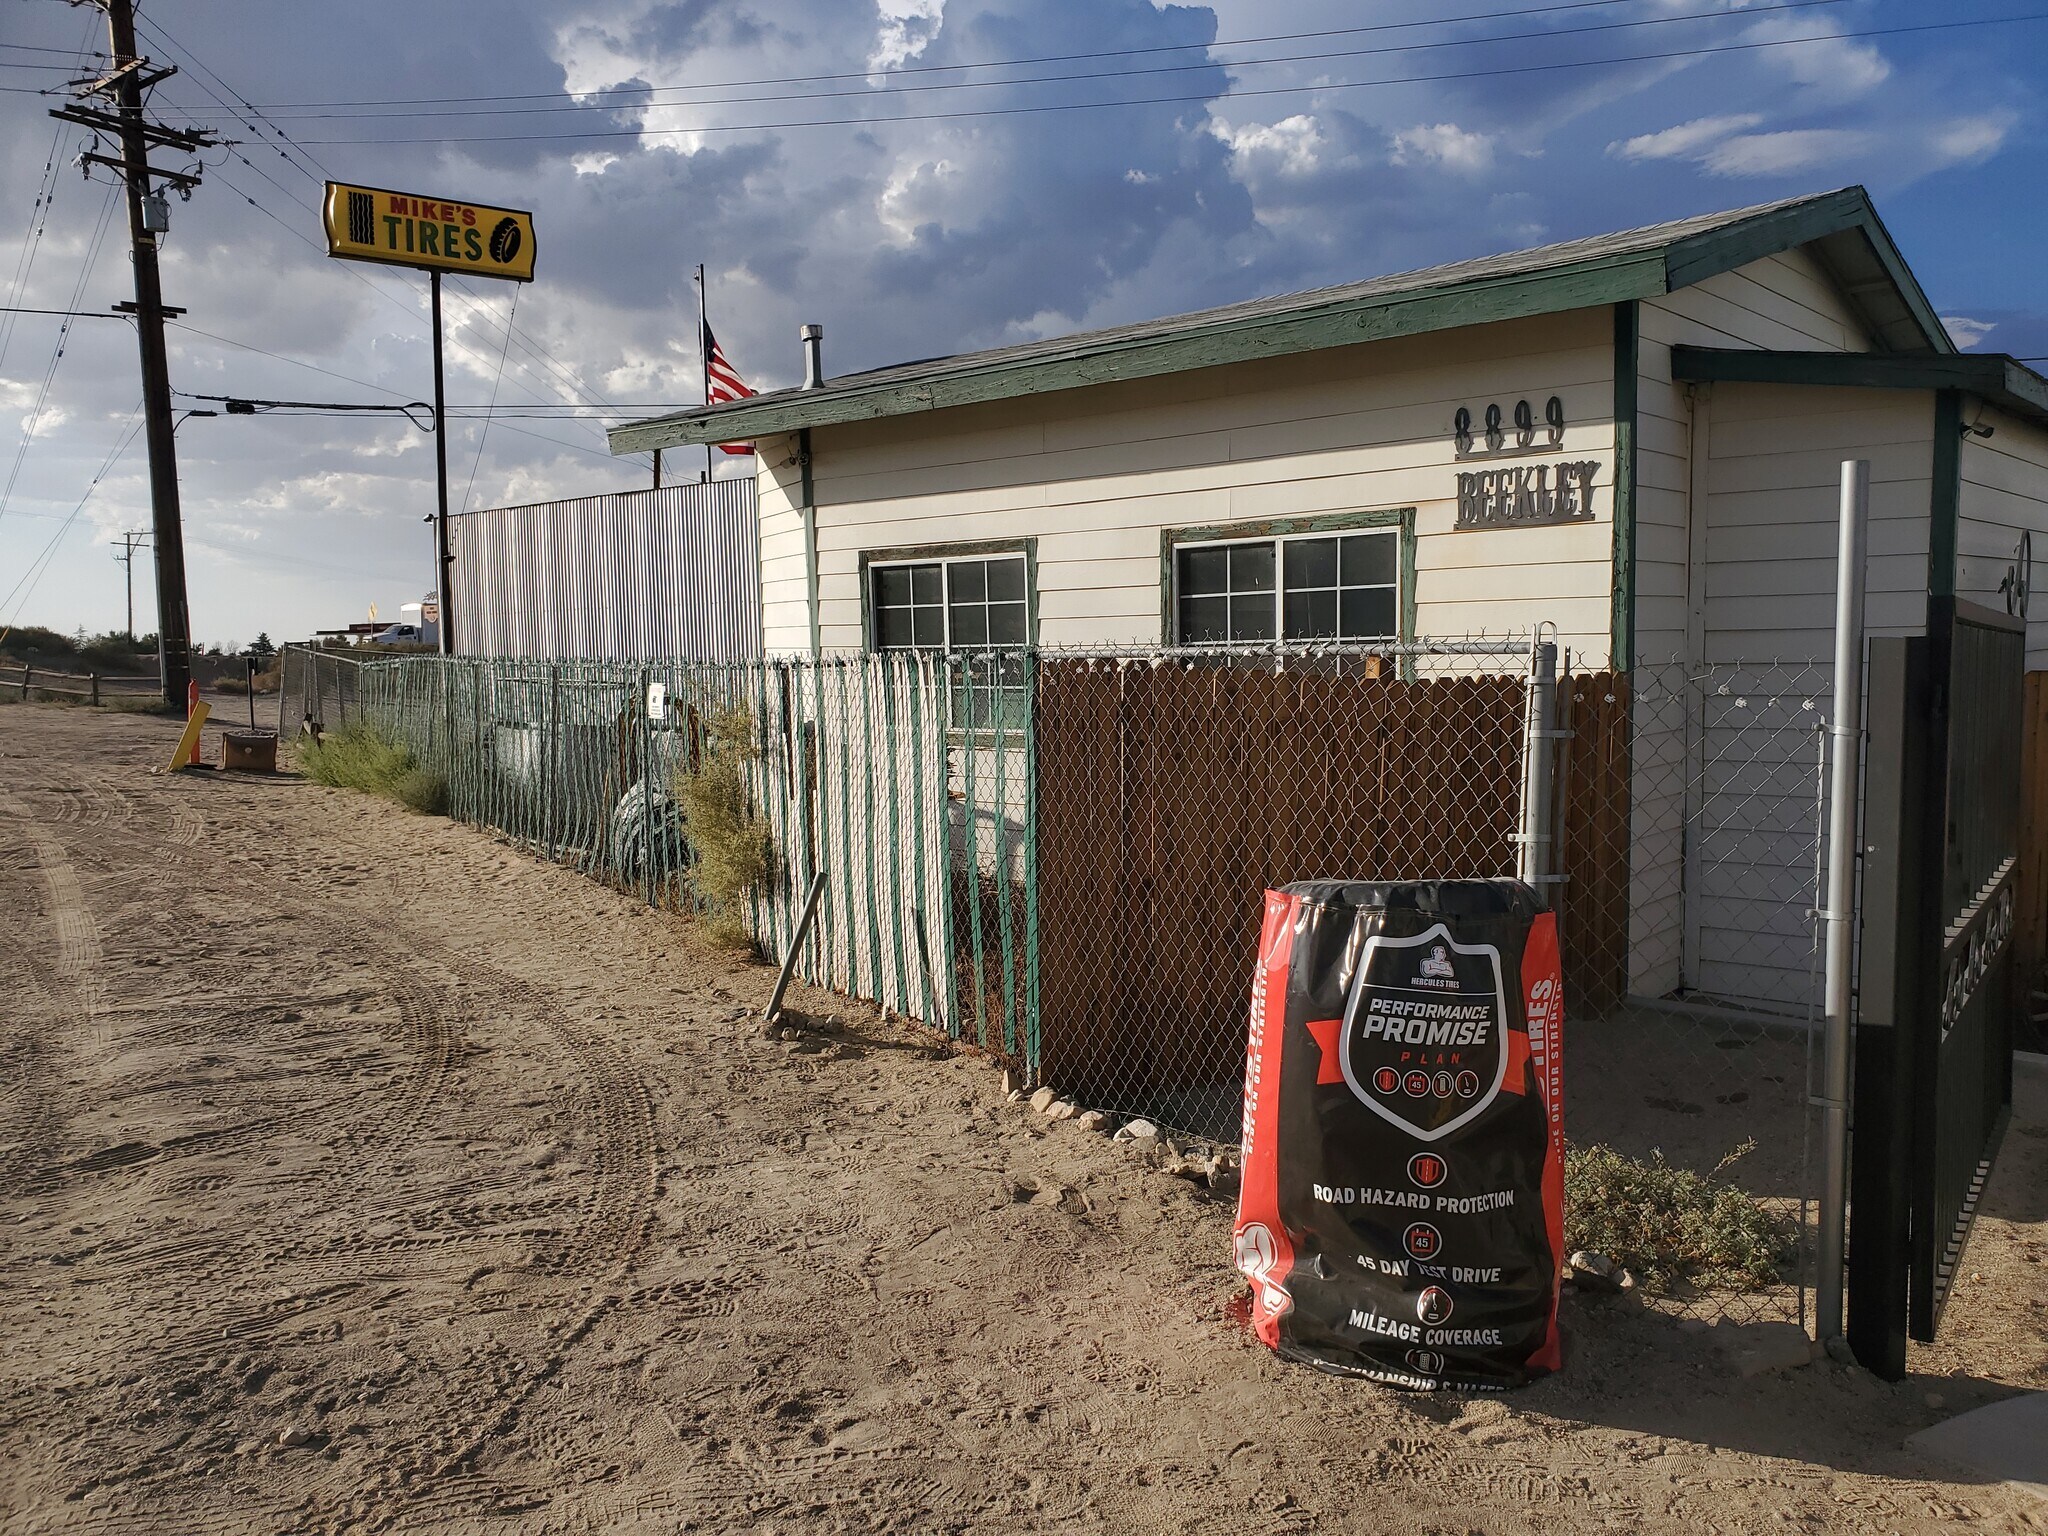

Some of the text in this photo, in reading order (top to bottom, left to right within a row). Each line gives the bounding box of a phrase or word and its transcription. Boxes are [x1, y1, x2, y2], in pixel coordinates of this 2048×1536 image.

[390, 196, 476, 226] MIKE'S
[383, 215, 483, 261] TIRES
[1454, 460, 1602, 526] BEEKLEY
[1411, 977, 1460, 989] HERCULES TIRES
[1369, 998, 1490, 1019] PERFORMANCE
[1362, 1014, 1491, 1045] PROMISE
[1411, 1081, 1421, 1089] 45
[1551, 1066, 1560, 1096] OUR
[1551, 1104, 1560, 1122] ON
[1313, 1184, 1514, 1214] ROAD HAZARD PROTECTION
[1416, 1237, 1428, 1248] 45
[1357, 1254, 1501, 1283] 45 DAY TEST DRIVE
[1349, 1309, 1502, 1345] MILEAGE COVERAGE
